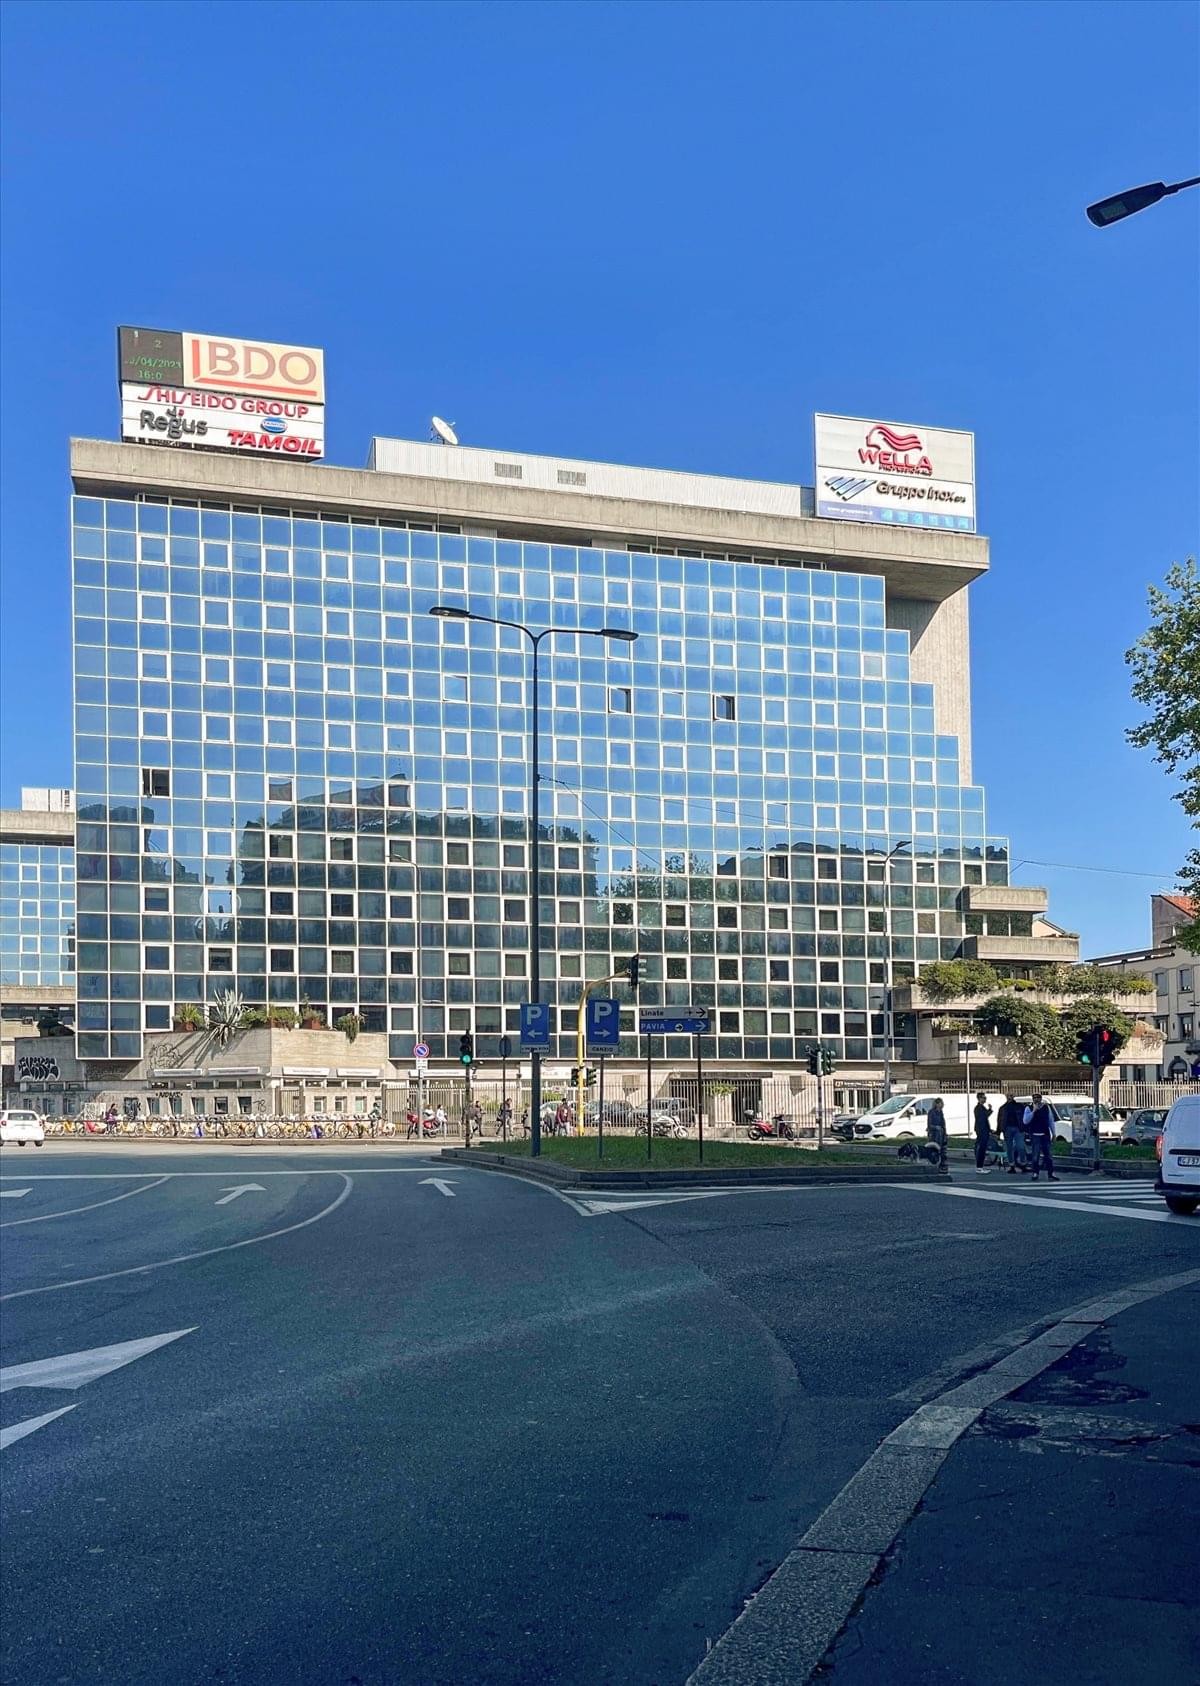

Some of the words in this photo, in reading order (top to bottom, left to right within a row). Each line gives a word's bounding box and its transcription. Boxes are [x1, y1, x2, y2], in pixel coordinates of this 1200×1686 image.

[207, 341, 317, 386] BDO
[137, 386, 237, 411] SHISEIDO
[241, 399, 309, 419] GROUP
[140, 408, 208, 440] Regus
[227, 429, 322, 455] TAMOIL
[857, 447, 933, 471] WELLA
[876, 480, 927, 500] Gruppo
[527, 1005, 543, 1025] P
[594, 1002, 612, 1024] P
[641, 1009, 664, 1017] Linate
[641, 1023, 665, 1031] PAVIA
